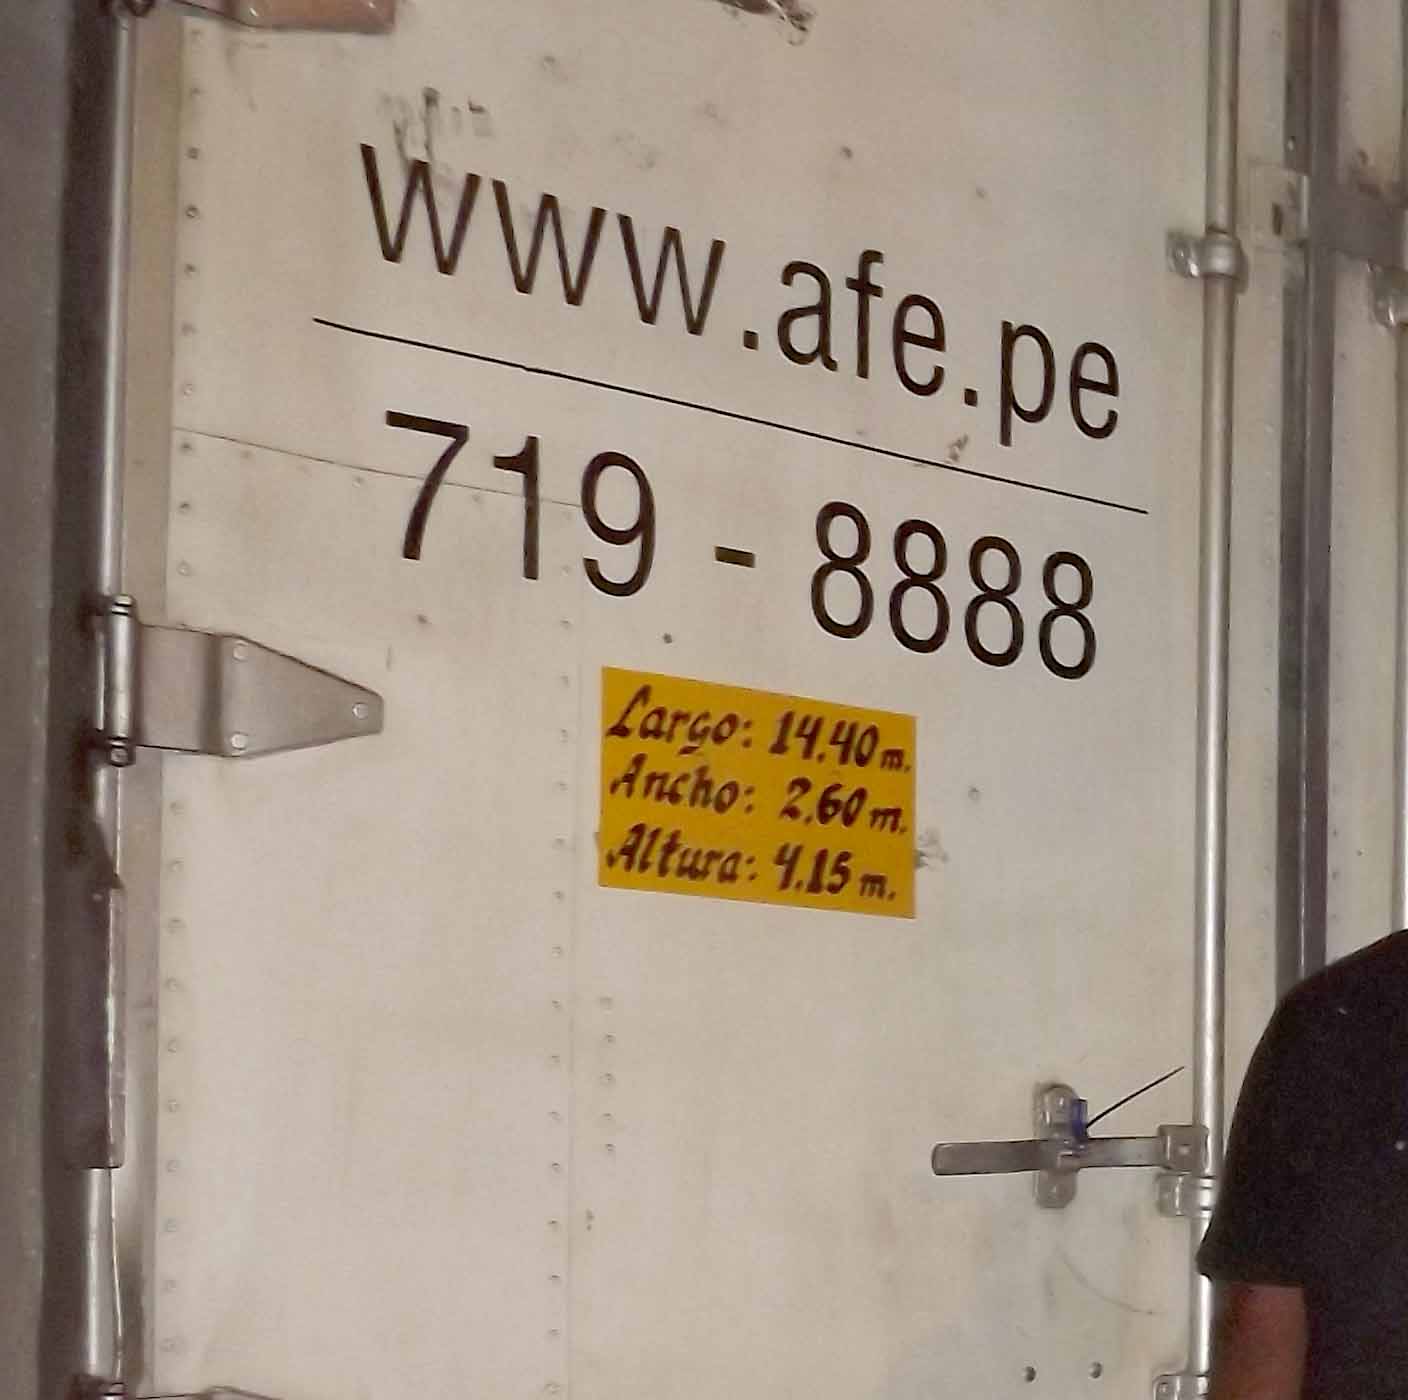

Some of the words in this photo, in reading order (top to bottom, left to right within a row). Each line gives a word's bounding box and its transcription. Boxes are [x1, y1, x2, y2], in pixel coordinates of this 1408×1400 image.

[359, 142, 1120, 447] www.afe.pe
[385, 410, 658, 598] 719
[809, 500, 1098, 680] 8888
[606, 684, 752, 755] Largo:
[768, 710, 879, 768] 14.40
[609, 752, 755, 814] Ancho:
[778, 777, 868, 827] 2.60
[606, 822, 757, 884] Altura:
[773, 842, 853, 895] 4.15
